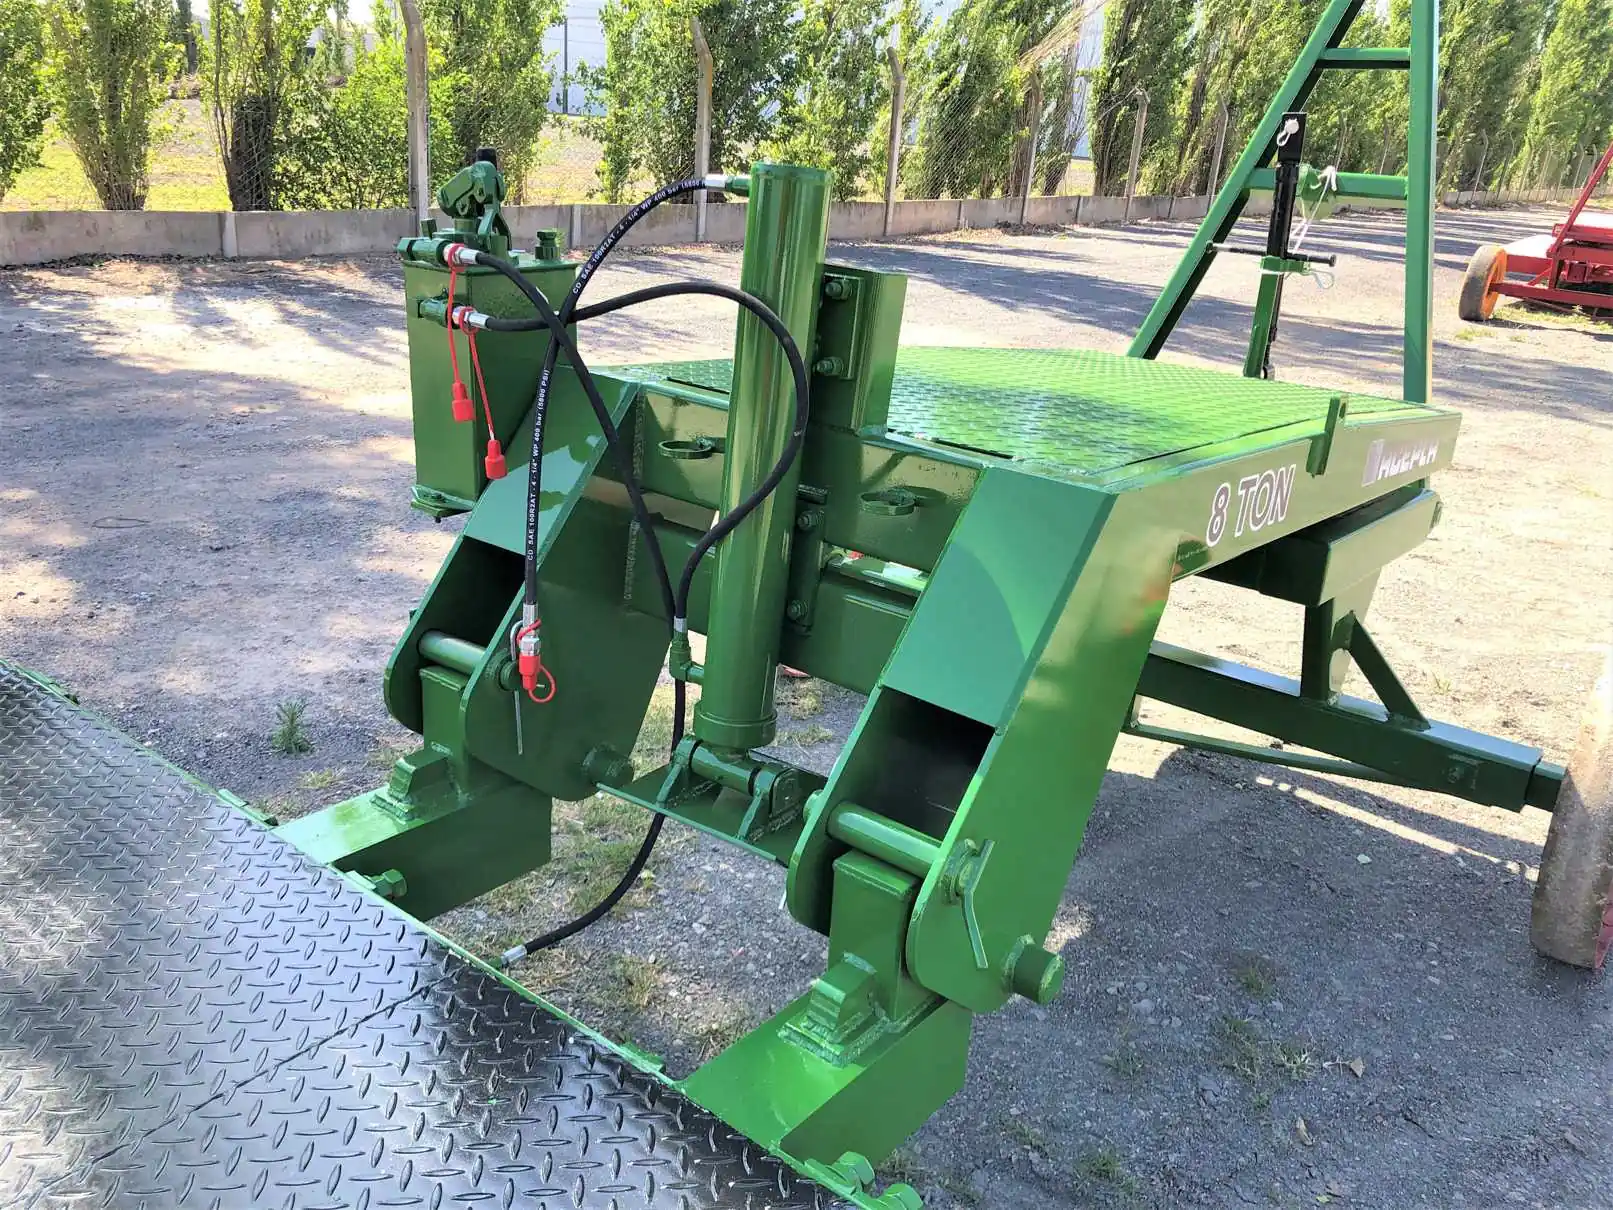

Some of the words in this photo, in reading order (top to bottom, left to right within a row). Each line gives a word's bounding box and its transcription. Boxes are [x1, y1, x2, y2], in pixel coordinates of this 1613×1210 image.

[572, 282, 582, 294] CD
[581, 263, 594, 279] SAE
[535, 412, 543, 426] bar
[532, 443, 540, 457] WP
[529, 493, 537, 526] 100R2AT
[1206, 482, 1231, 547] 8
[1234, 463, 1297, 538] TON
[526, 549, 534, 561] CD
